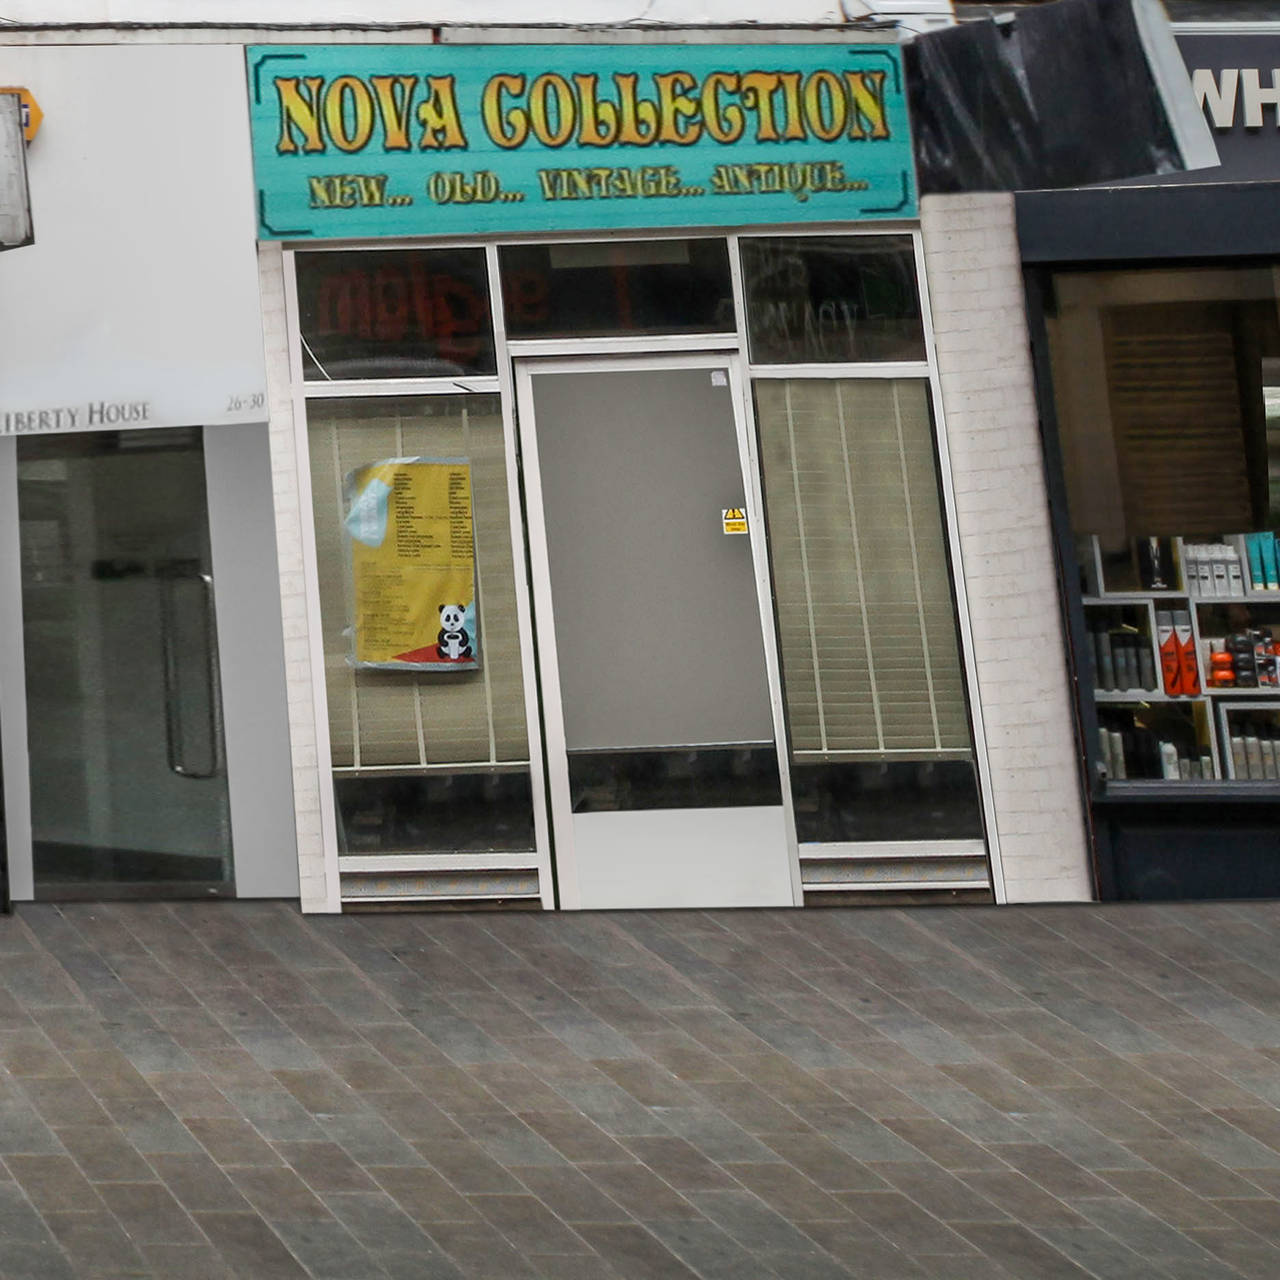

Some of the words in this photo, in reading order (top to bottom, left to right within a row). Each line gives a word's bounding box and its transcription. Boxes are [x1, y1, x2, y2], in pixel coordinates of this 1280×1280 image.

[274, 74, 468, 154] NOVA
[481, 70, 890, 149] COLLECTION
[88, 401, 150, 426] HOUSE
[226, 393, 265, 412] 26-30
